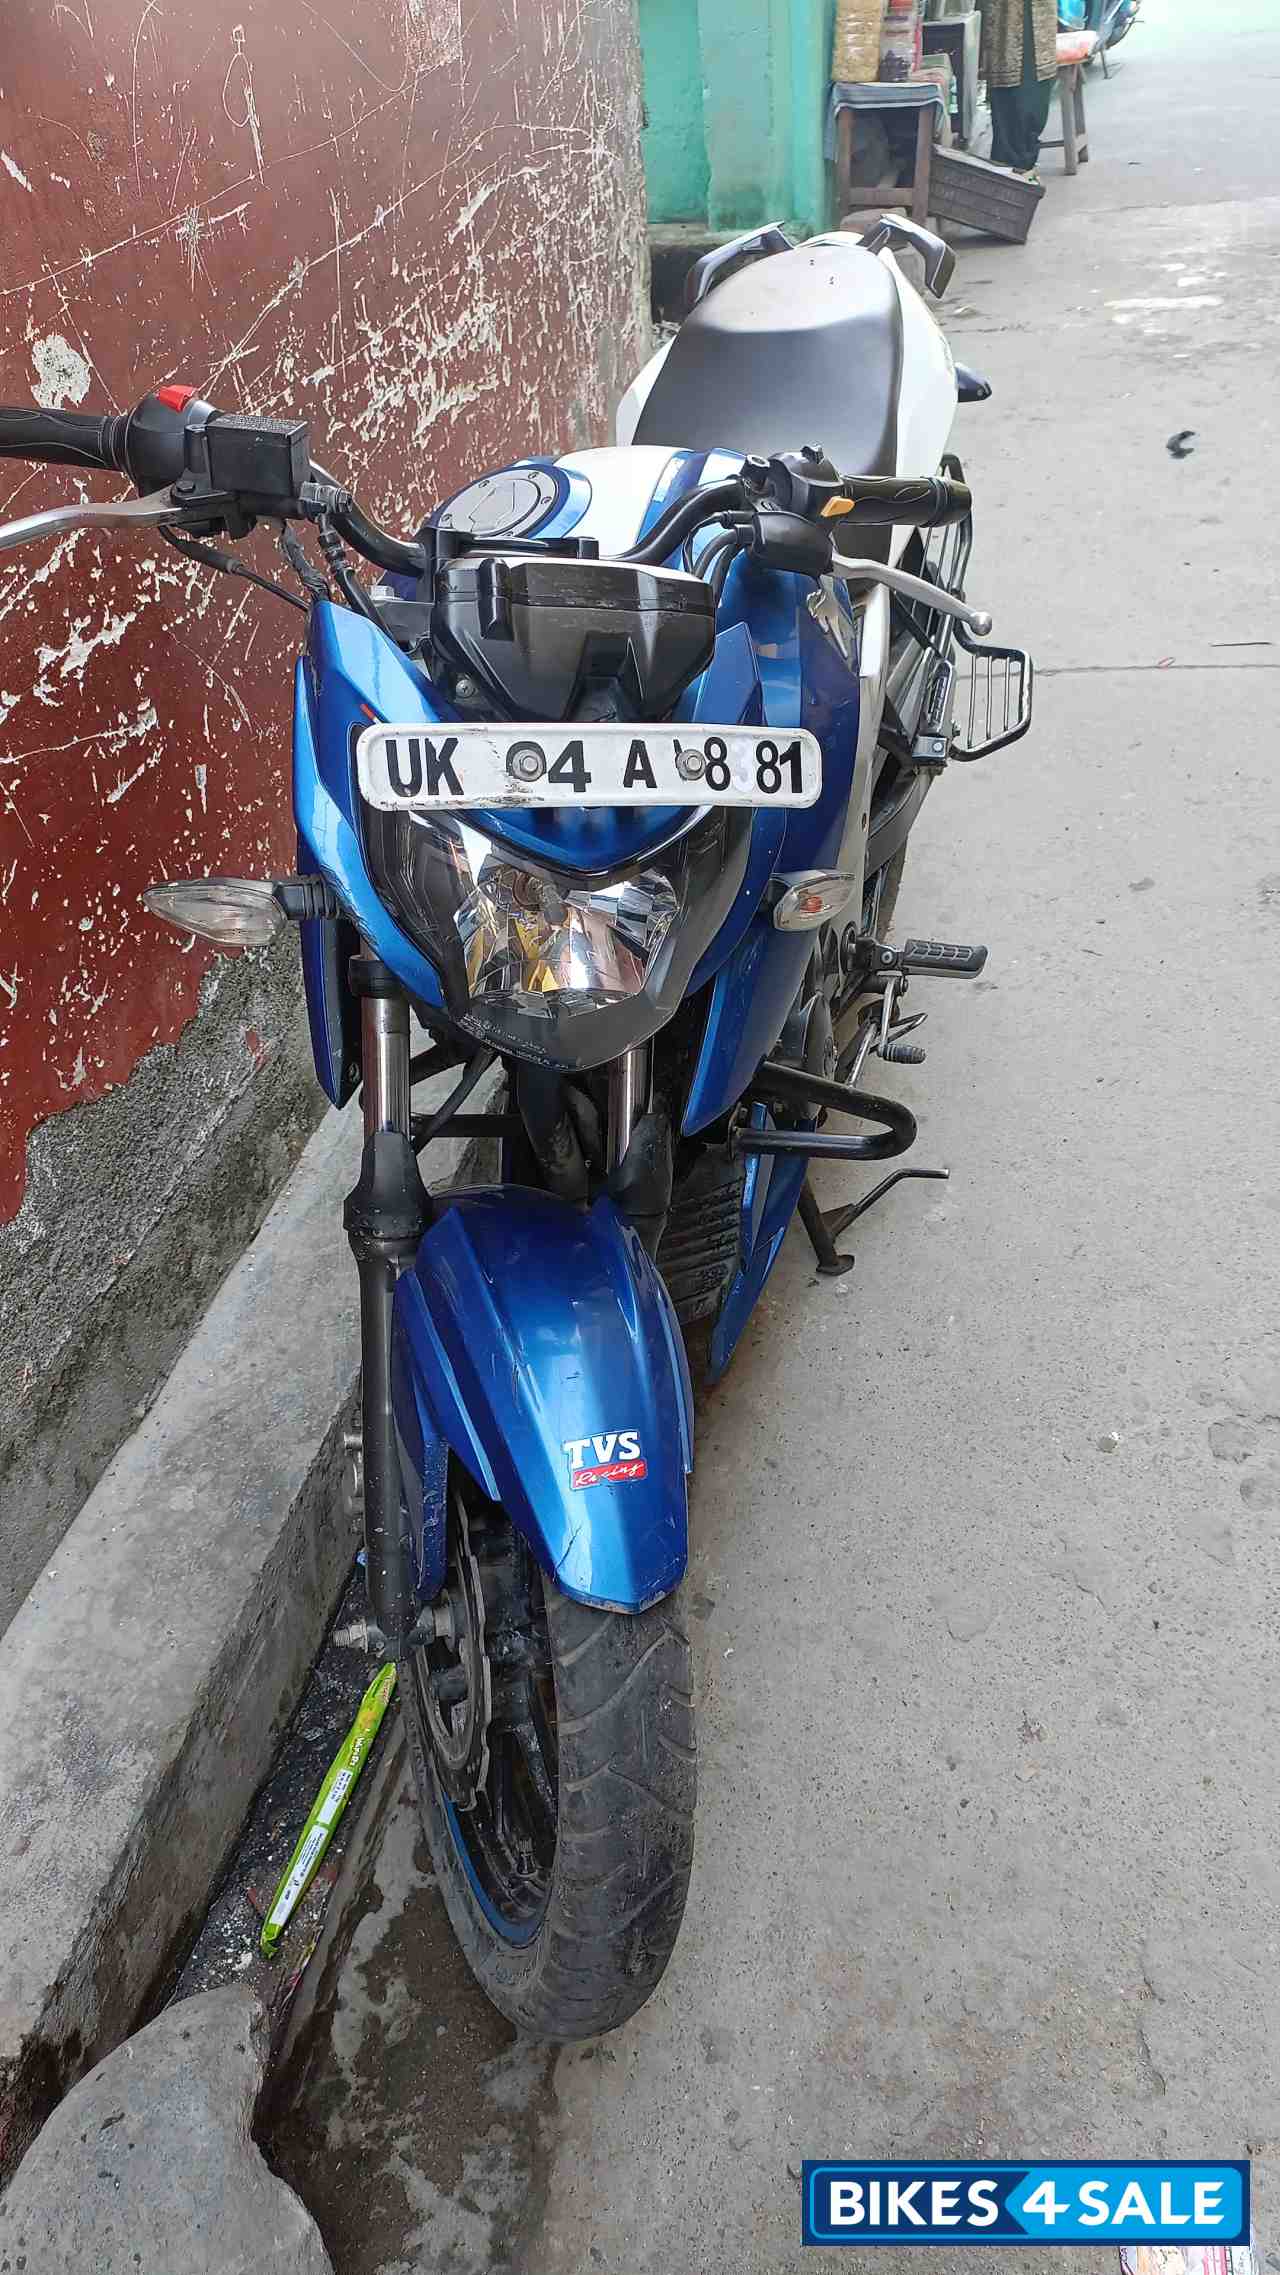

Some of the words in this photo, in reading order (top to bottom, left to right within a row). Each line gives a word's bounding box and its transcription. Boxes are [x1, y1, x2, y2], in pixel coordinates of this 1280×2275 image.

[385, 737, 464, 797] UK
[506, 740, 591, 793] 04
[563, 1431, 640, 1469] TVS
[575, 1462, 645, 1487] Racing
